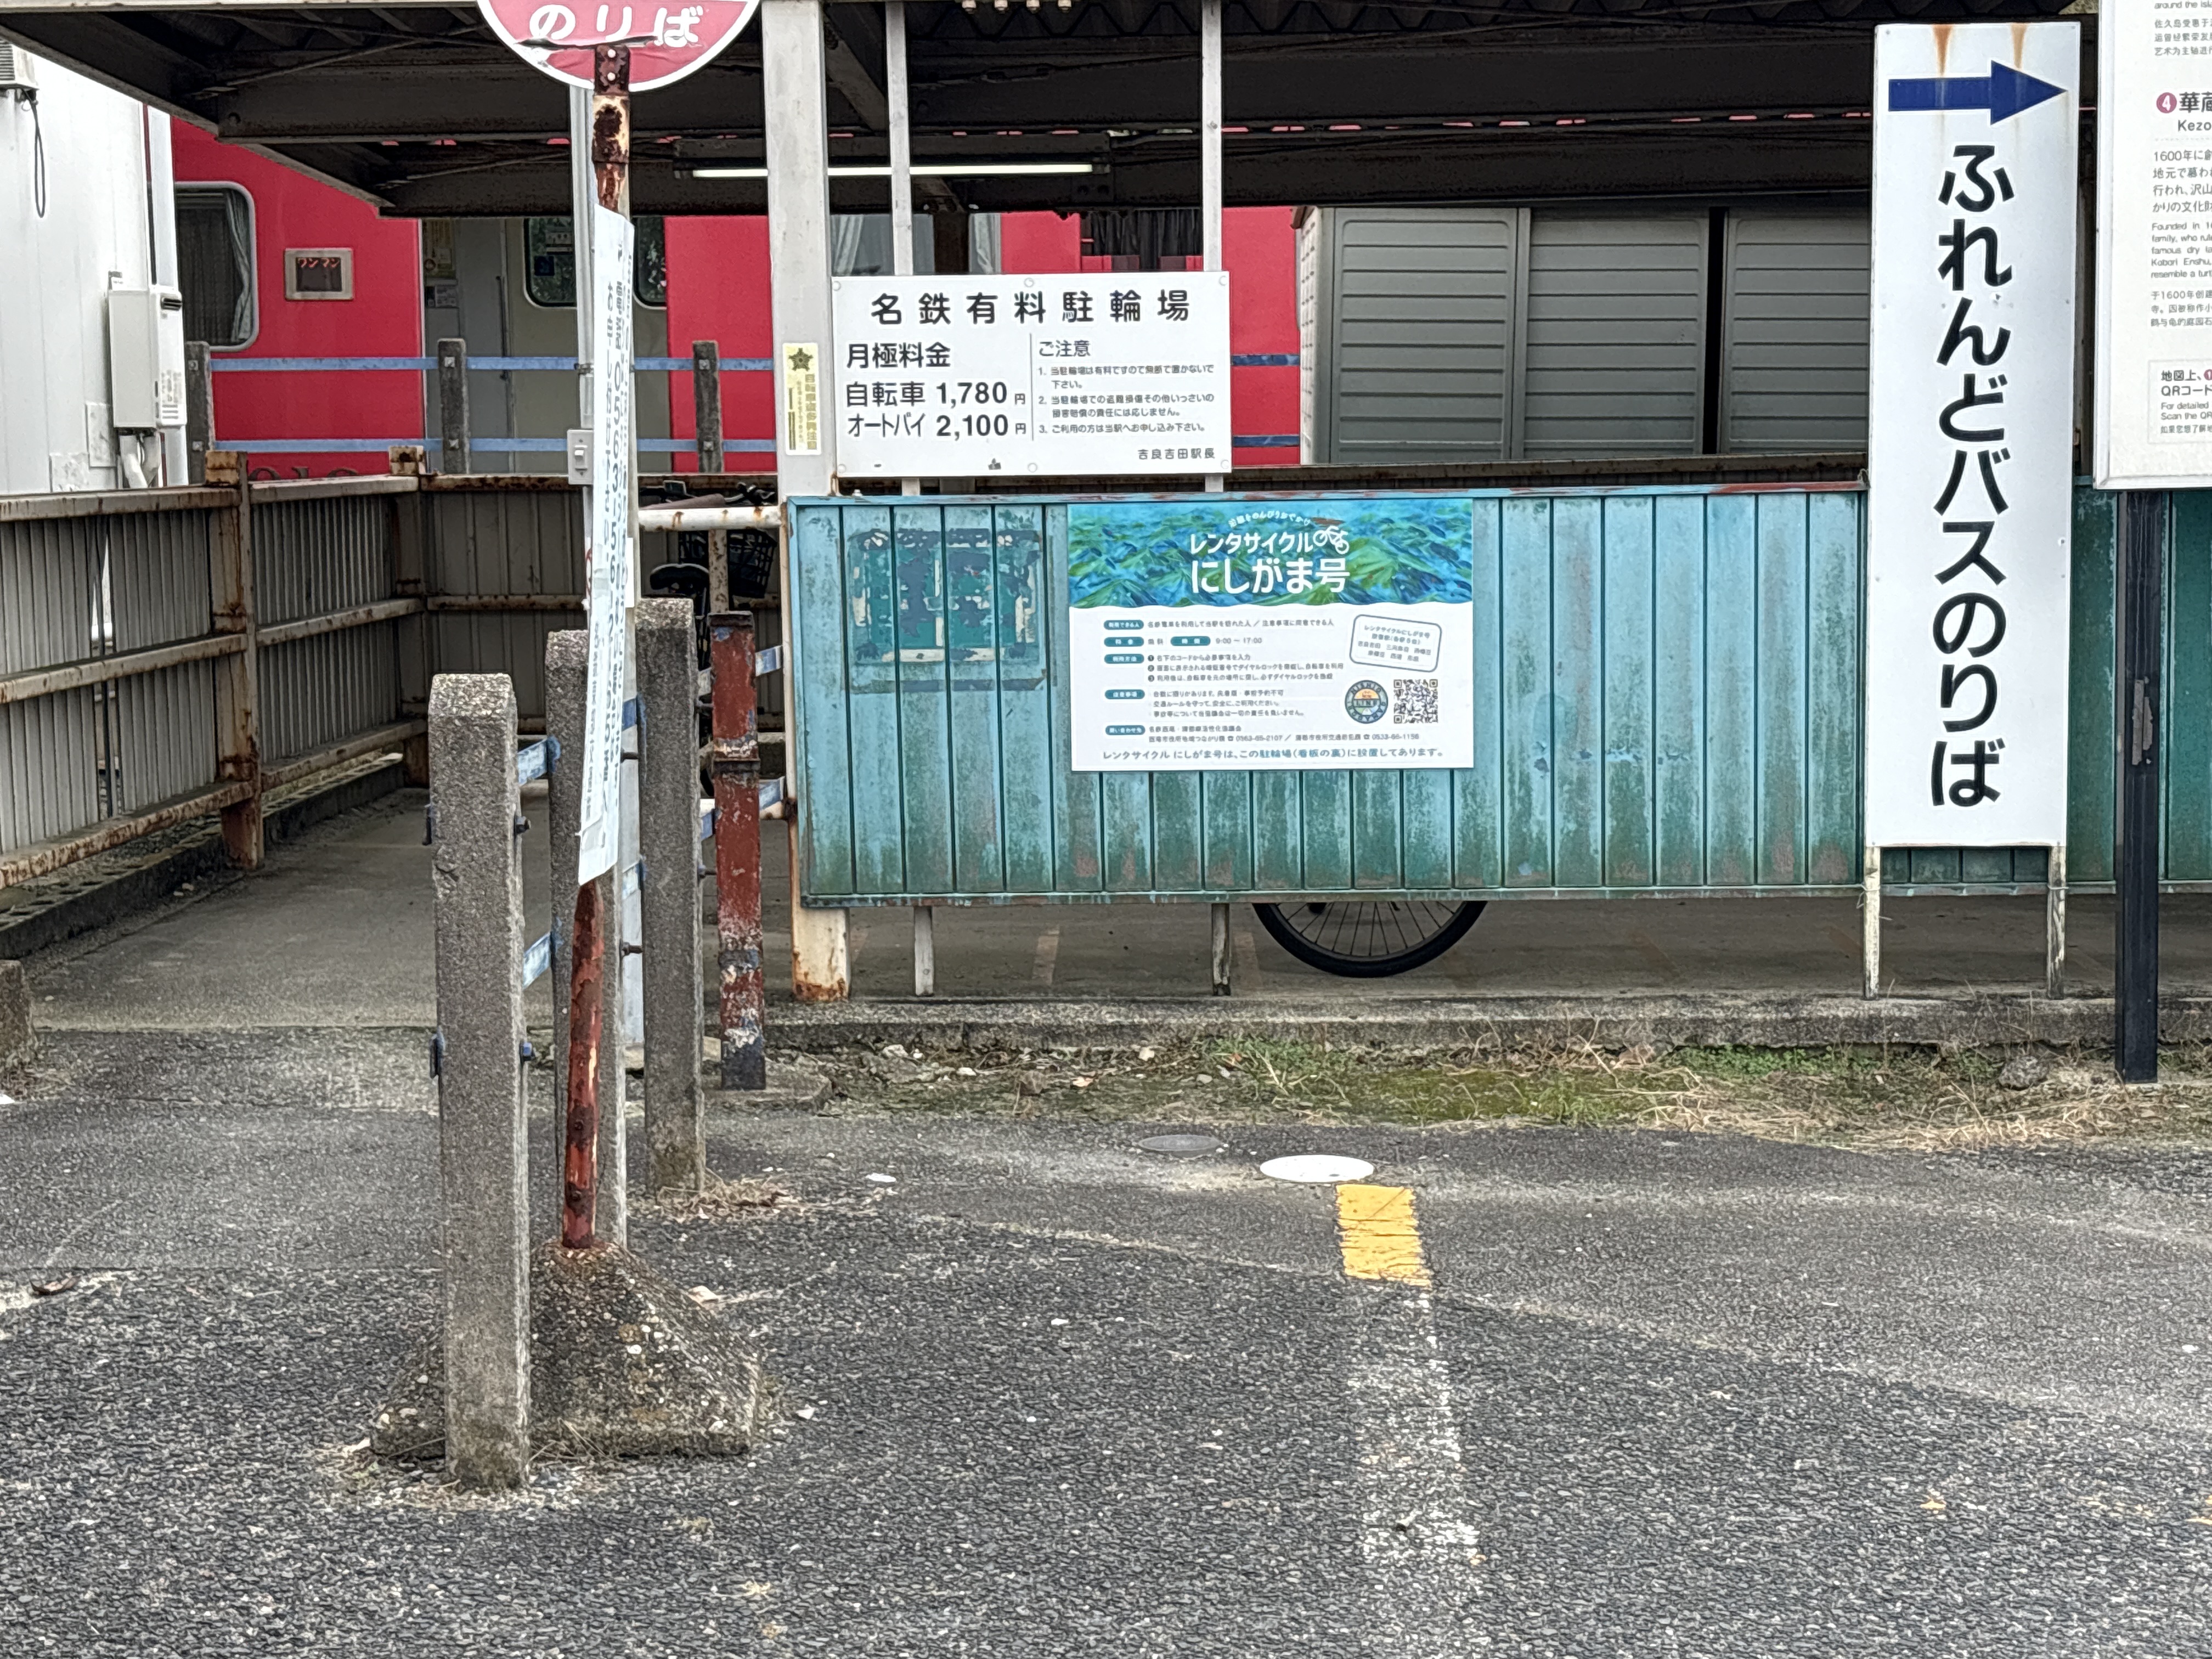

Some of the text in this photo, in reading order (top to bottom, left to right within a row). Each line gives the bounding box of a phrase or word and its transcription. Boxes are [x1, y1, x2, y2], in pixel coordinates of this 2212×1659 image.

[529, 4, 704, 48] のりば
[2178, 120, 2211, 131] Kezo
[2153, 167, 2212, 179] 地元で慕わ
[2152, 222, 2187, 230] Founded
[2187, 246, 2200, 255] dry
[871, 289, 1189, 325] 名鉄有料駐輪場
[847, 342, 950, 369] 月極料金
[1039, 340, 1090, 357] ご注意
[1051, 380, 1082, 389] 下さい。
[2161, 370, 2201, 381] 地図上、
[847, 381, 1025, 408] 自転車 1,780 円
[848, 412, 1026, 441] オートバイ 2,100 円
[1138, 448, 1215, 460] 吉良吉田駅長
[1930, 144, 2016, 809] ふれんどバスのりば
[1190, 531, 1313, 555] レンタサイクル
[1192, 557, 1351, 594] にしがま号
